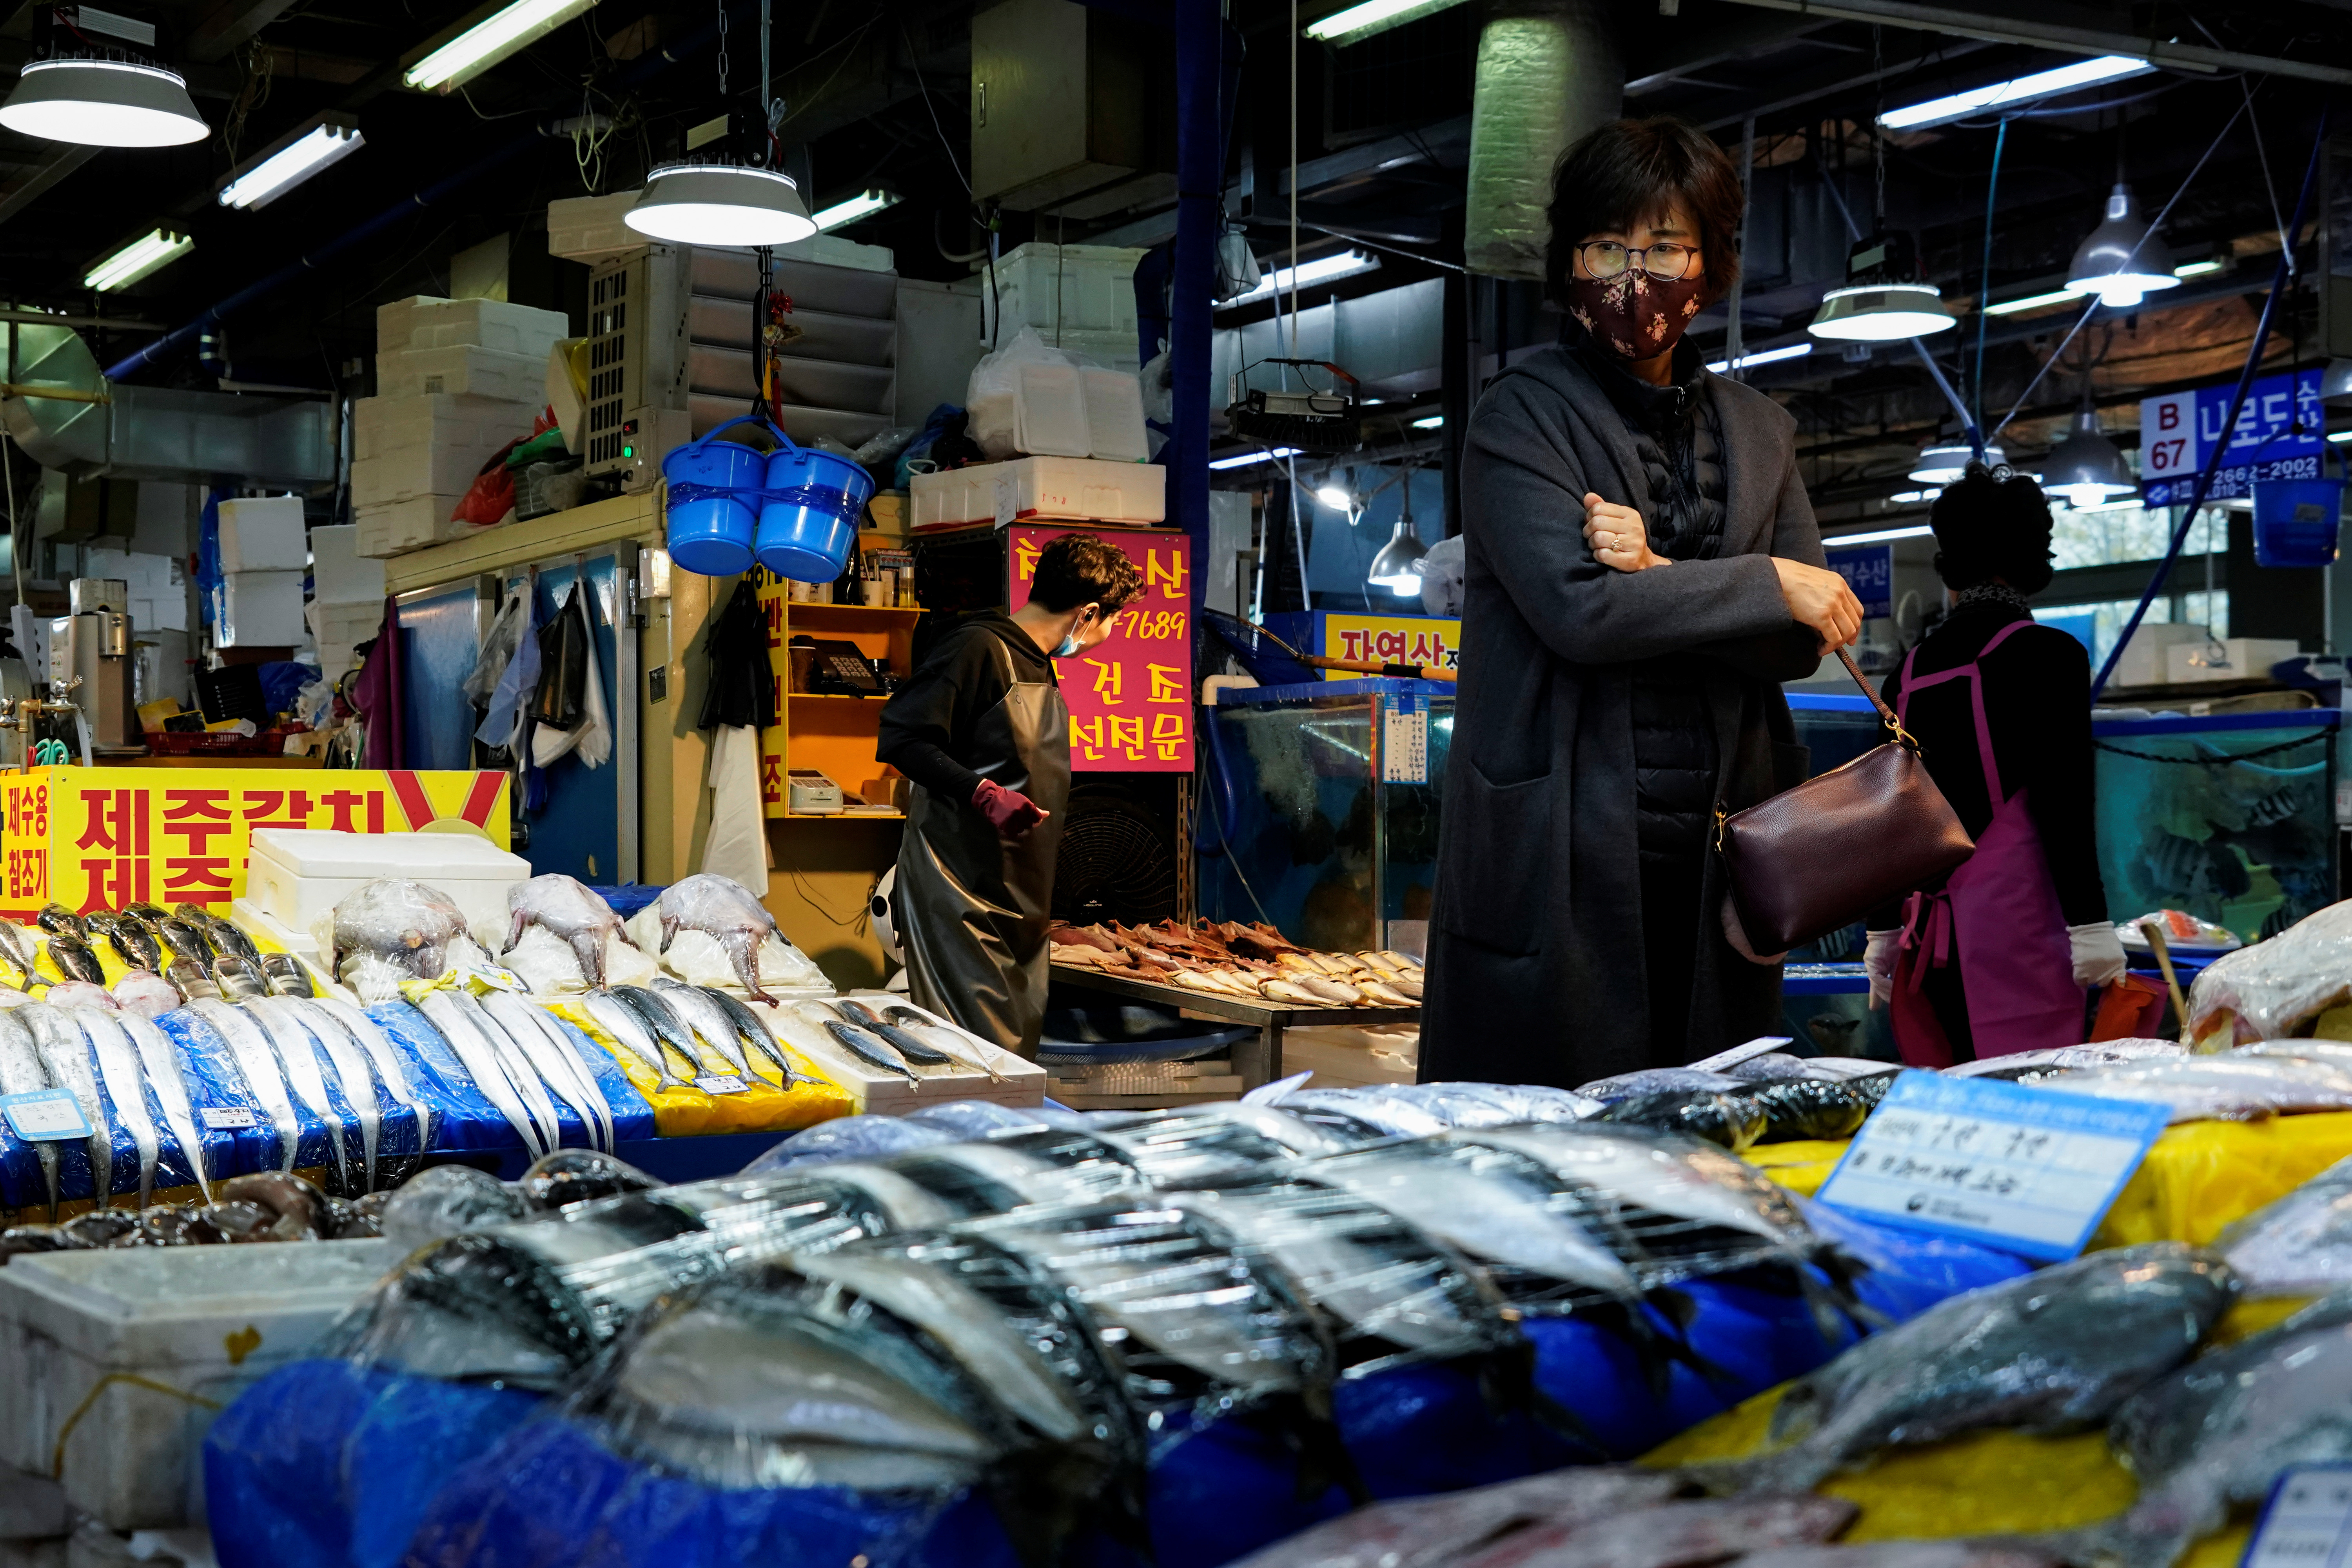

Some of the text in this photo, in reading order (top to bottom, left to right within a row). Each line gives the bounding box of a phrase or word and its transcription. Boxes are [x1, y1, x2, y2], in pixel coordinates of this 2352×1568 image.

[2158, 403, 2179, 431] B
[2151, 437, 2186, 470] 67
[8, 785, 47, 837] 제수용
[74, 789, 384, 856] 제주갈치
[9, 849, 47, 899] 참조기
